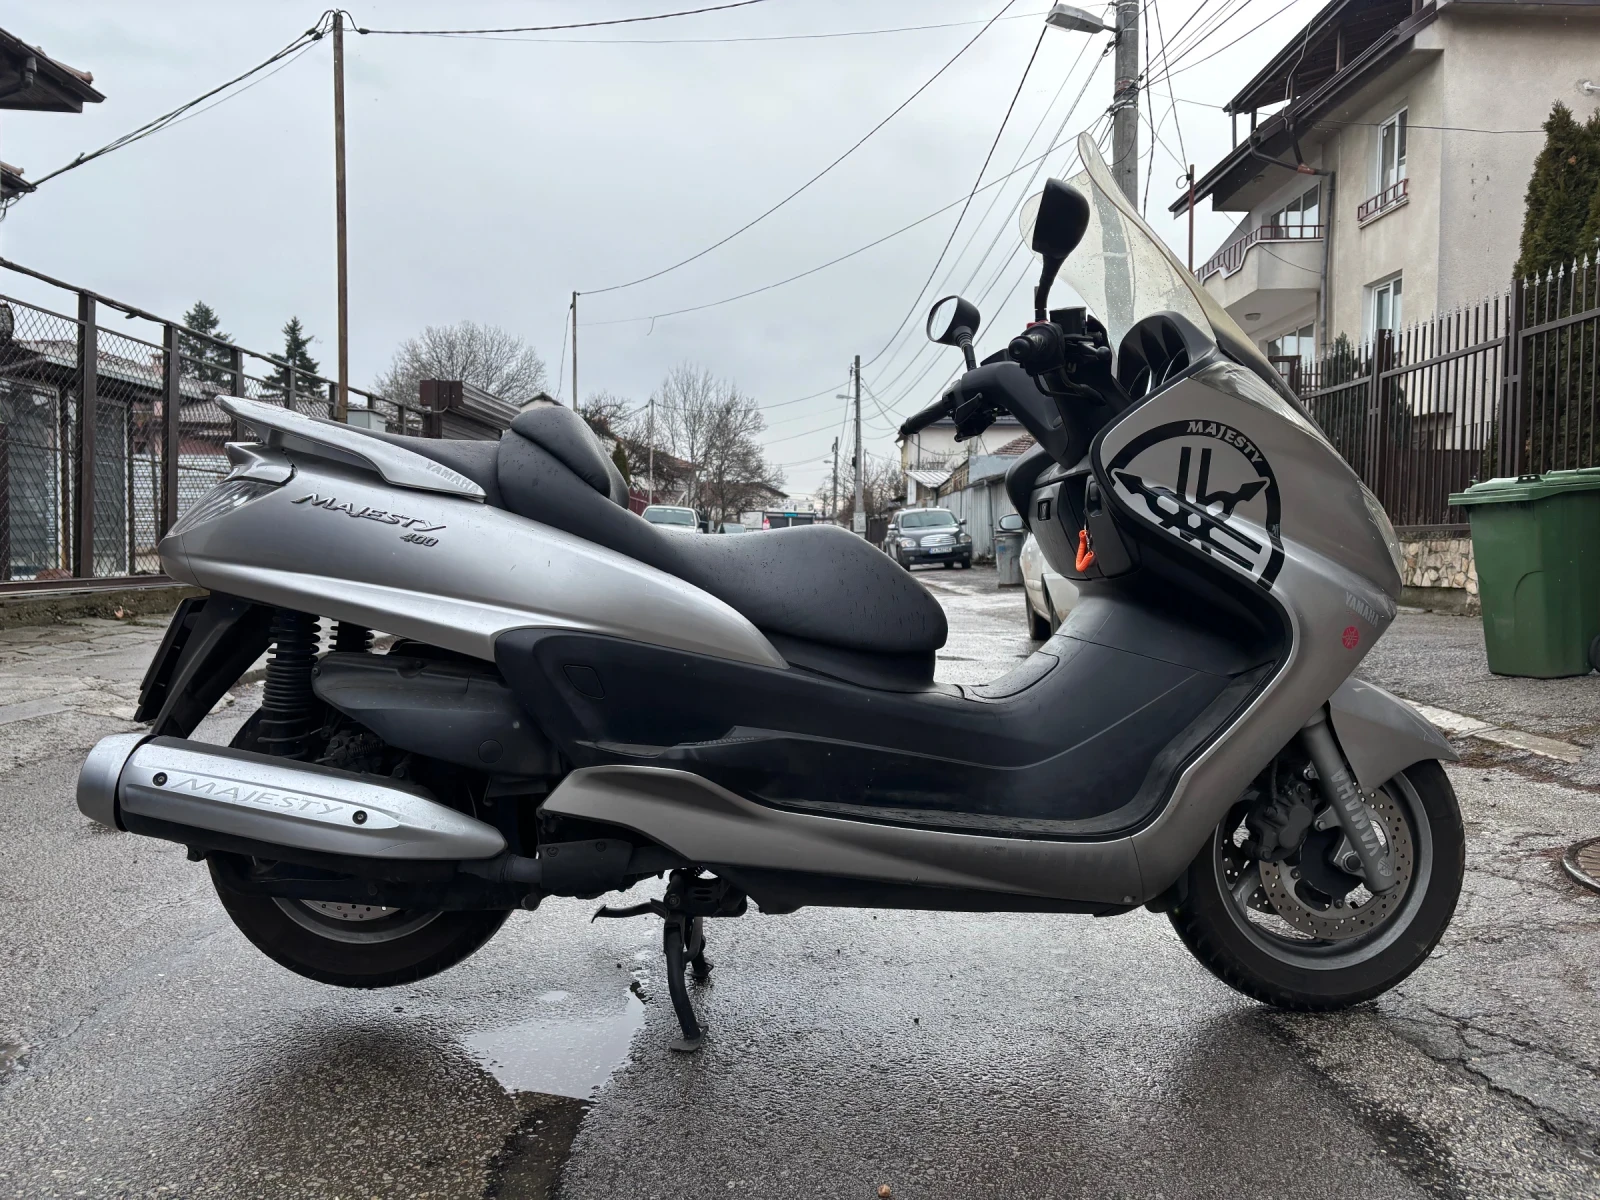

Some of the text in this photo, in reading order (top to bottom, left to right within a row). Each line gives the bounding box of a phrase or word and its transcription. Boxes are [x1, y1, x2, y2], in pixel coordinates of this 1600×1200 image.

[1187, 420, 1264, 465] MAJESTY
[425, 461, 481, 495] YAMAHA
[290, 492, 447, 531] MAJESTY
[400, 532, 440, 547] 400
[1345, 591, 1379, 628] YAMAHA
[173, 777, 346, 816] MAJESTY
[1330, 767, 1380, 857] YAMAHA
